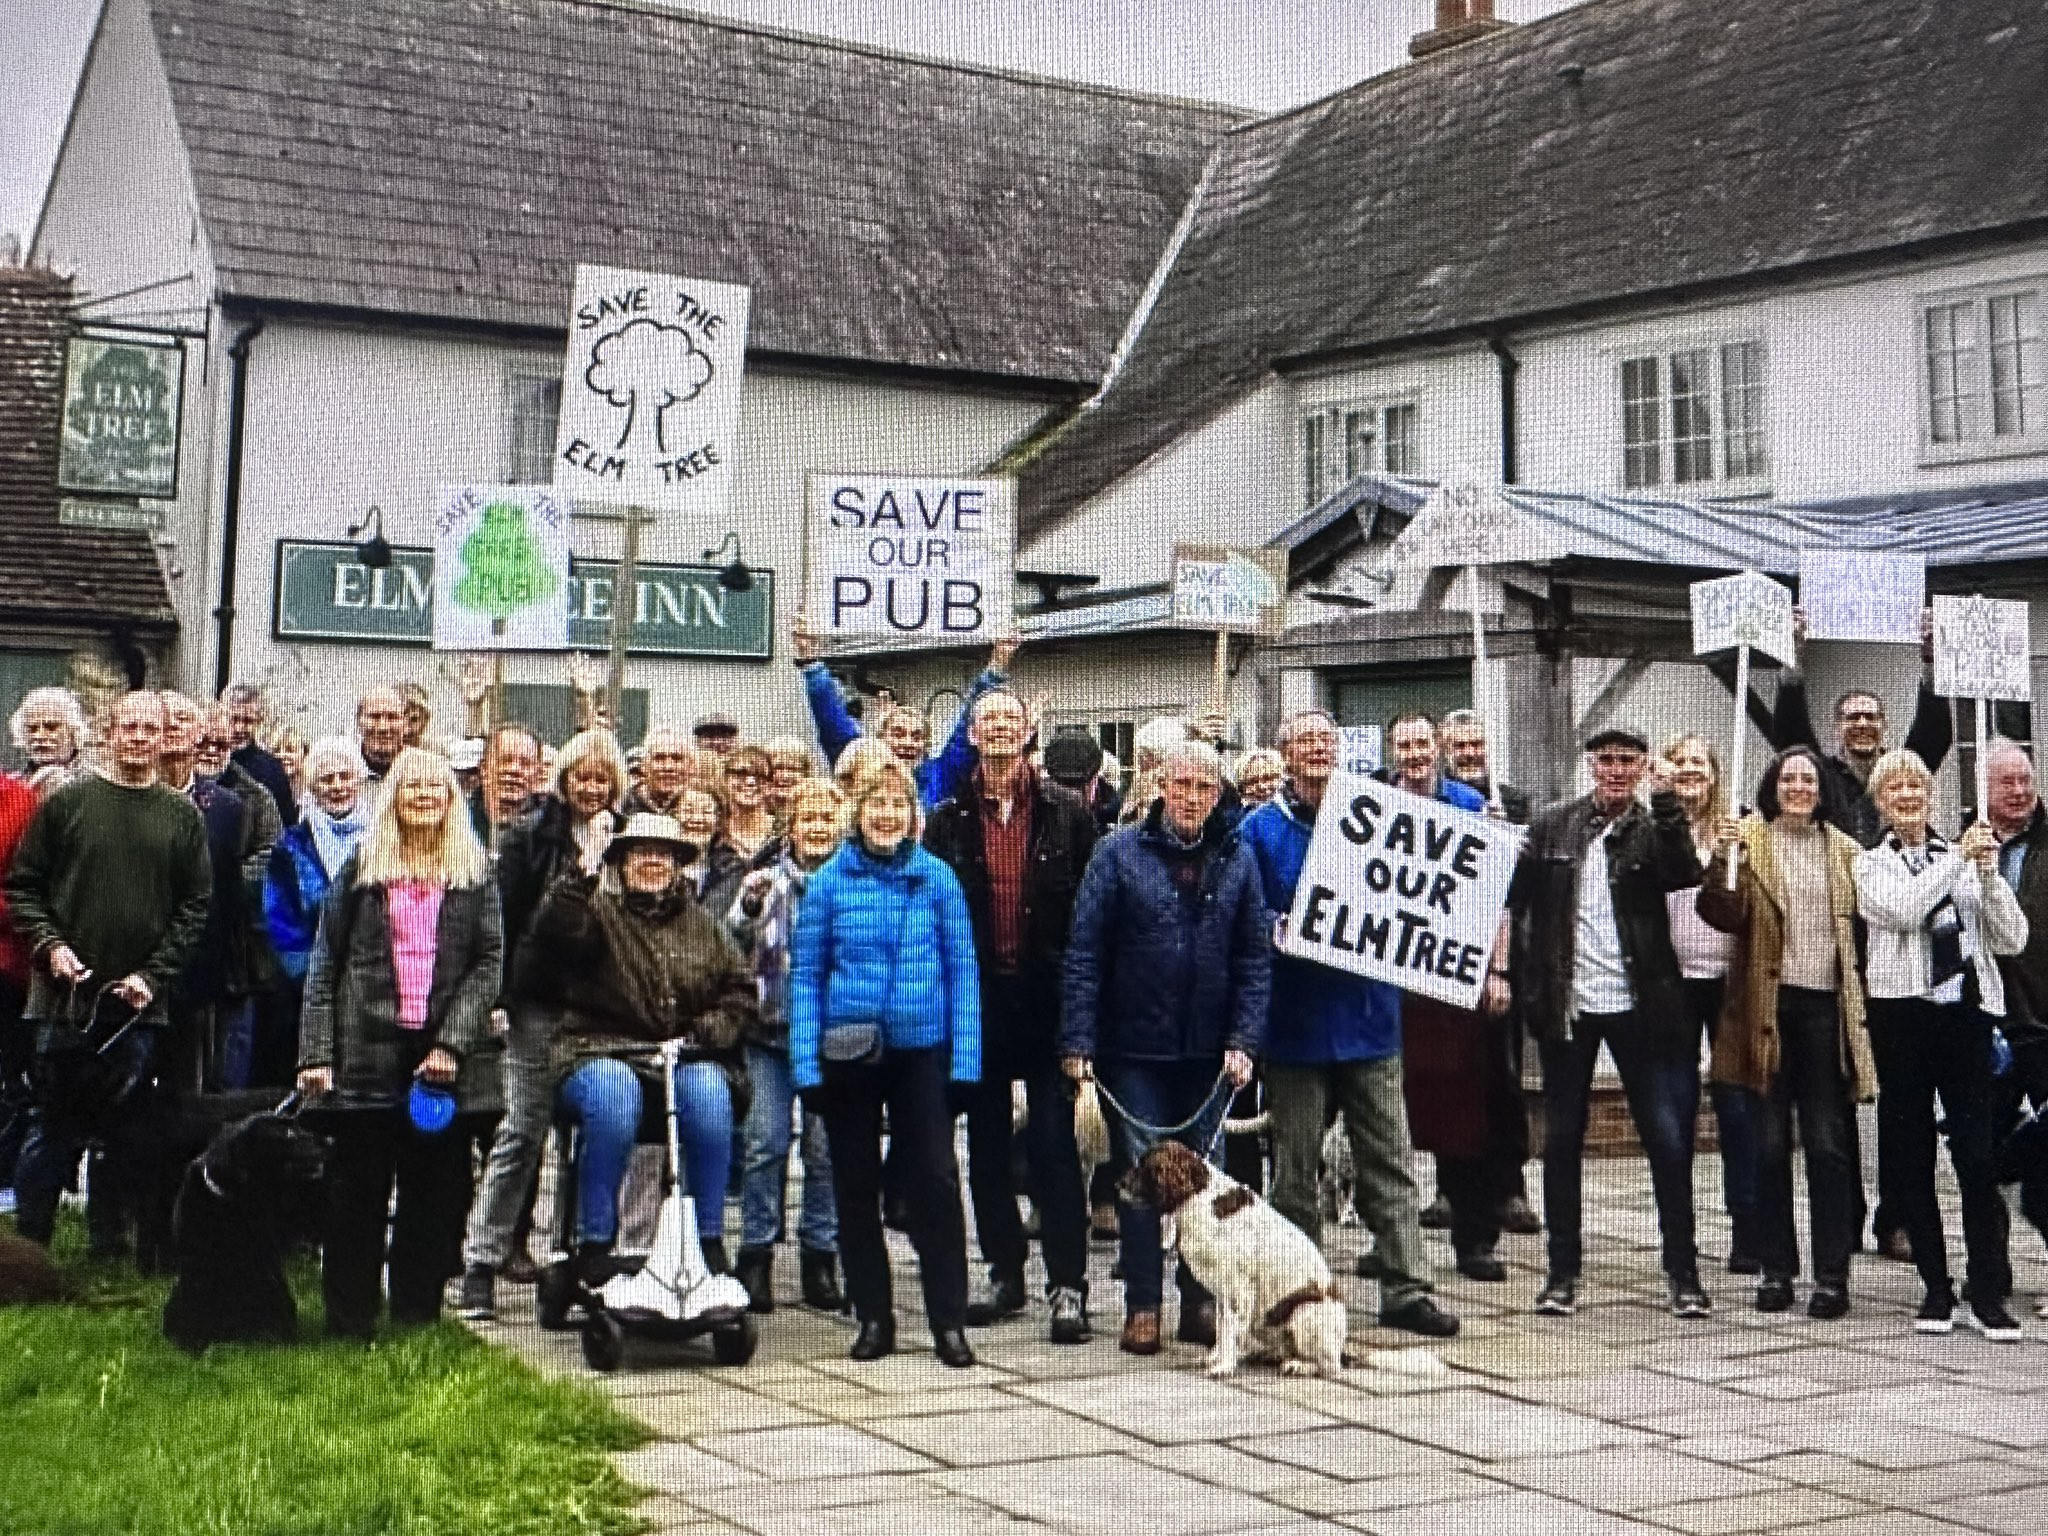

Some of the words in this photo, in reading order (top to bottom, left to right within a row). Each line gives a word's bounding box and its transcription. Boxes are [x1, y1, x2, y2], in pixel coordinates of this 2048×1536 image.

[577, 287, 650, 331] SAVE
[677, 292, 725, 339] THE
[94, 381, 153, 411] ELM
[84, 412, 162, 440] TREE
[563, 438, 627, 480] ELM
[655, 444, 721, 483] TREE
[436, 486, 481, 536] SAVE
[831, 486, 985, 531] SAVE
[868, 537, 950, 567] OUR
[334, 562, 434, 611] ELM
[636, 579, 726, 627] INN
[833, 576, 983, 632] PUB
[1339, 795, 1486, 877] SAVE
[1365, 858, 1456, 914] OUR
